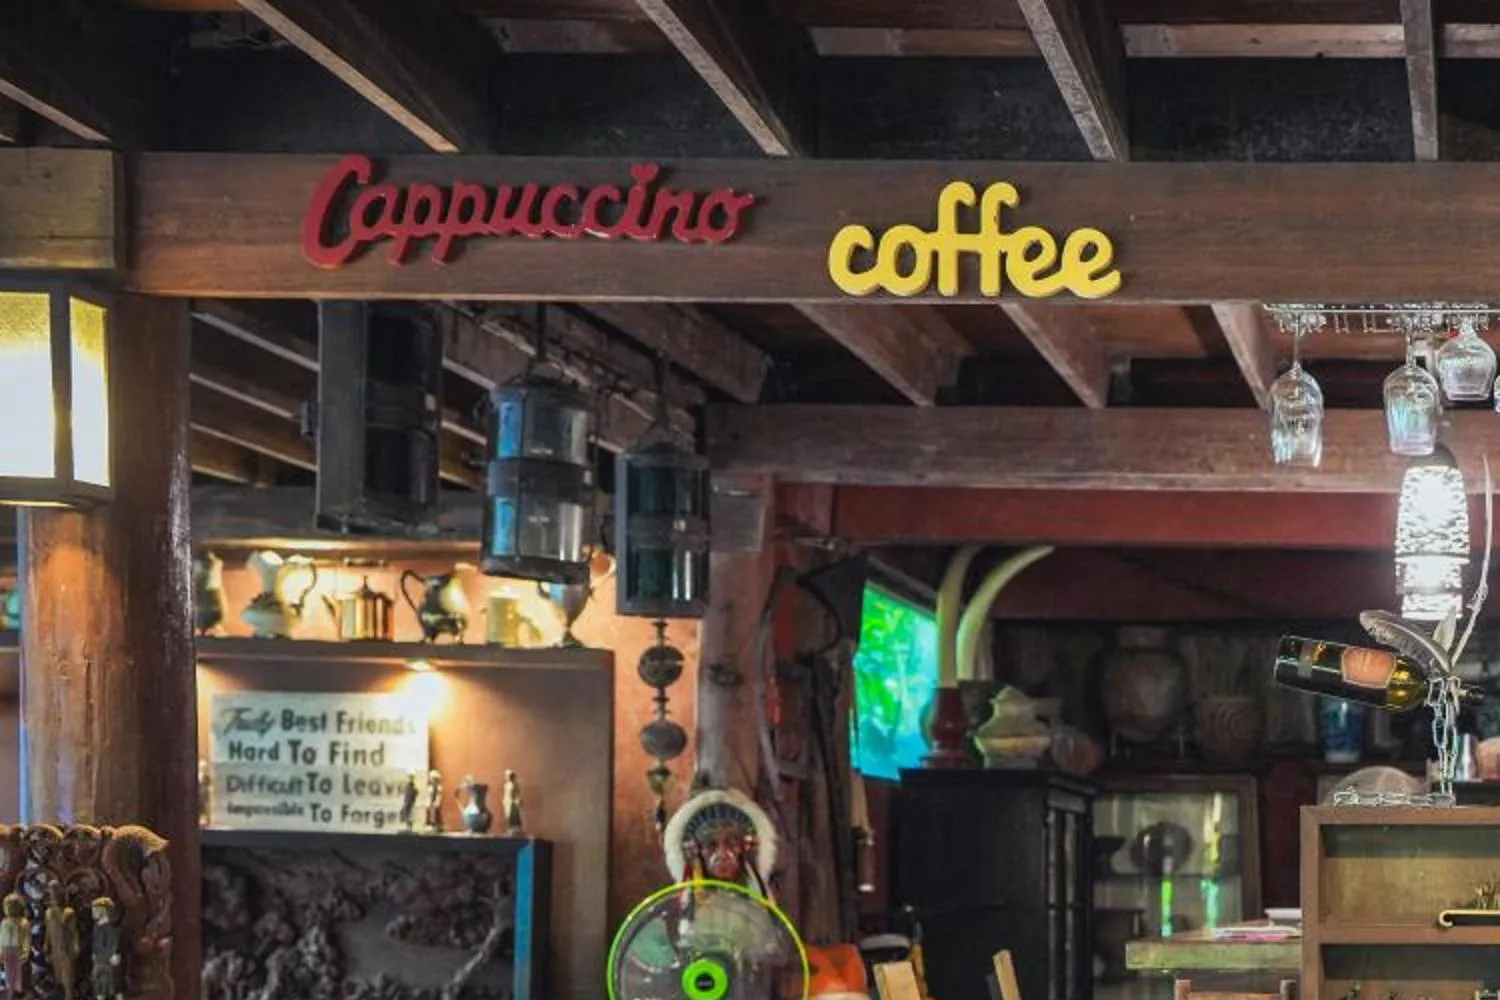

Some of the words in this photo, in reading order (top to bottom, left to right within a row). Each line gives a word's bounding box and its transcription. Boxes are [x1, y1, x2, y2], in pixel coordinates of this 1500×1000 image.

[305, 153, 755, 269] Cappuccino
[828, 181, 1121, 298] coffee
[281, 709, 327, 732] Best
[336, 710, 416, 734] Friends
[228, 740, 280, 761] Hard
[288, 739, 317, 765] To
[329, 741, 386, 766] Find
[226, 774, 303, 795] Difficult
[306, 772, 333, 795] To
[309, 802, 333, 822] To
